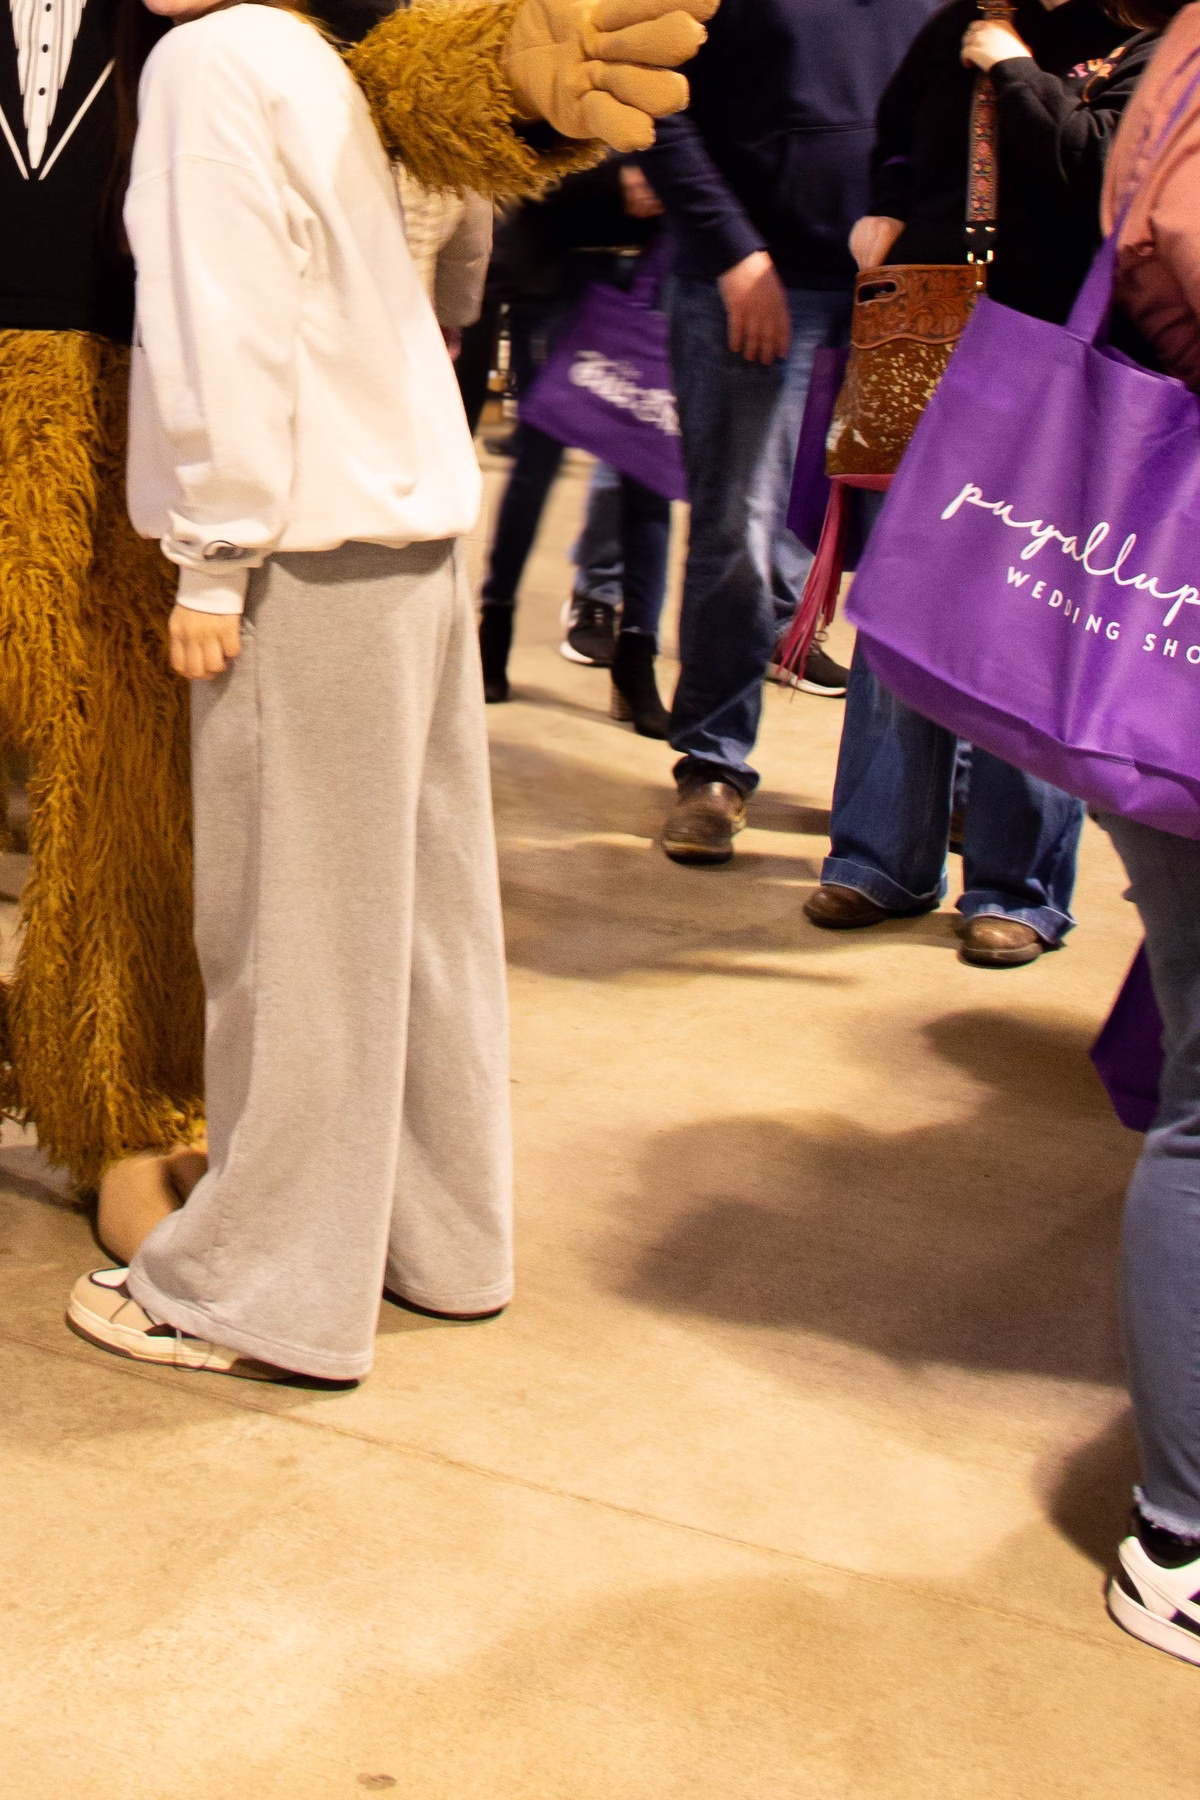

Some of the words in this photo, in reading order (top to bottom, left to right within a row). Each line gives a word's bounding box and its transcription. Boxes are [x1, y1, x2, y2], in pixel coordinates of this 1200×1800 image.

[941, 482, 1200, 627] puyallup
[1007, 566, 1121, 641] WEDDING
[1142, 633, 1200, 665] SHO
